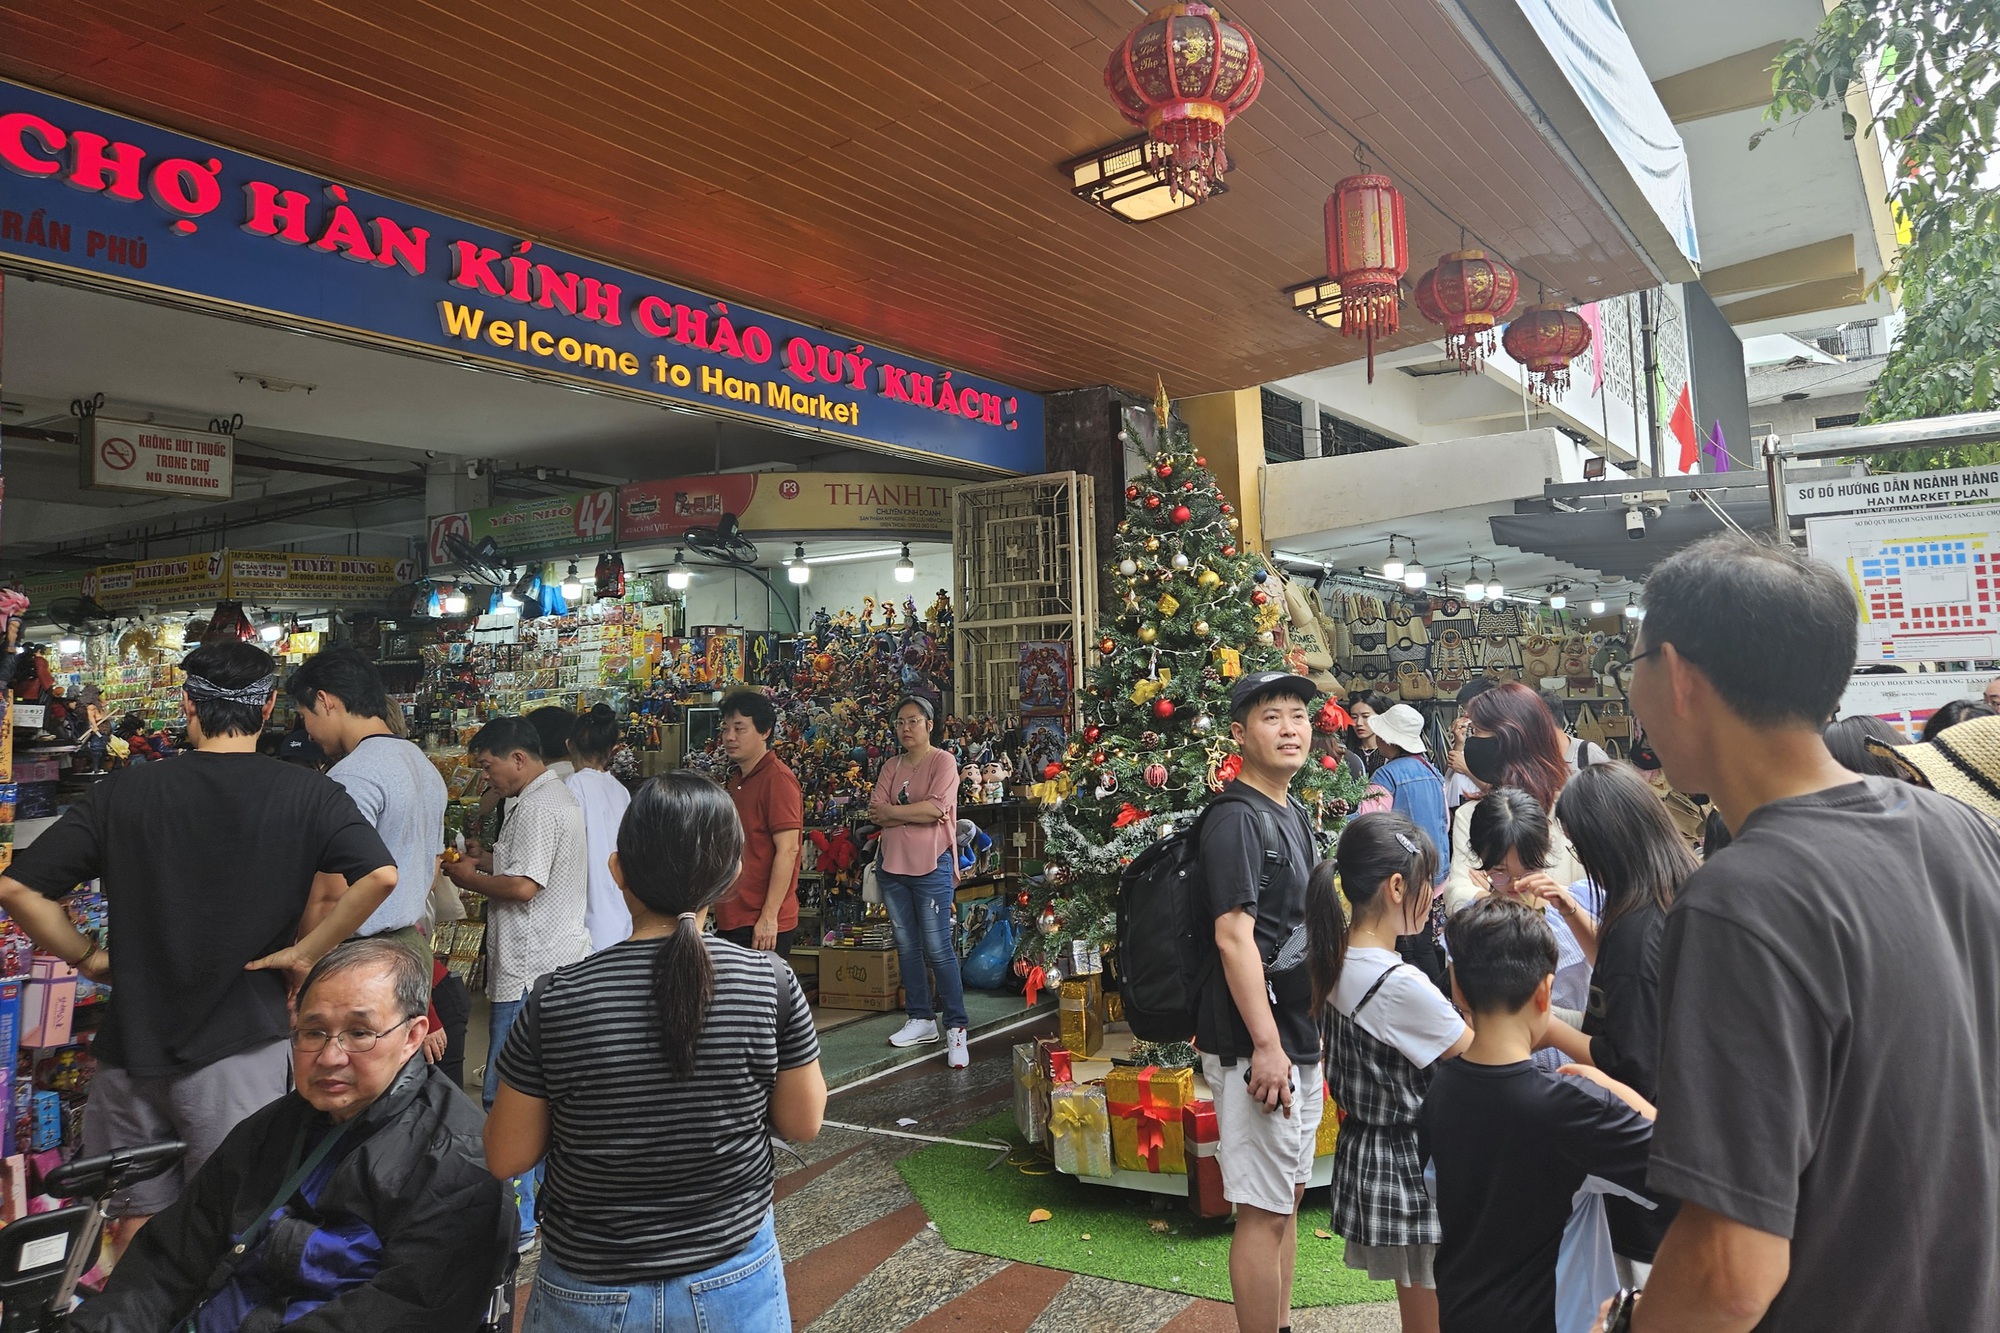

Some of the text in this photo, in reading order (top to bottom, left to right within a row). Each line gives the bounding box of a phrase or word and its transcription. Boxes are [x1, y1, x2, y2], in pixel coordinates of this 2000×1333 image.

[0, 208, 147, 269] RẦN PHÚ
[0, 112, 222, 235] CHỢ
[243, 181, 430, 276] HÀN
[454, 241, 622, 326] KÍNH
[638, 296, 772, 364] CHÀO
[786, 337, 872, 390] QUÝ
[882, 364, 1002, 426] KHÁCH
[442, 301, 859, 426] Welcome to Han Market
[138, 434, 226, 457] KHÔNG HÚT THUỐC
[156, 454, 211, 475] TRONG CHỢ
[146, 472, 219, 489] NO SMOKING
[783, 482, 797, 493] P3
[1798, 471, 1999, 500] SƠ ĐỒ HƯỚNG DẪN NGÀNH HÀNG
[824, 483, 922, 507] THANH
[1867, 496, 1895, 506] HAN
[1899, 491, 1950, 504] MARKET
[1955, 488, 1988, 499] PLAN
[578, 491, 612, 537] 42
[919, 509, 941, 517] DOANH
[291, 555, 336, 572] TUYẾT
[396, 563, 415, 579] 47
[82, 575, 97, 597] 48
[1289, 634, 1316, 644] COMES
